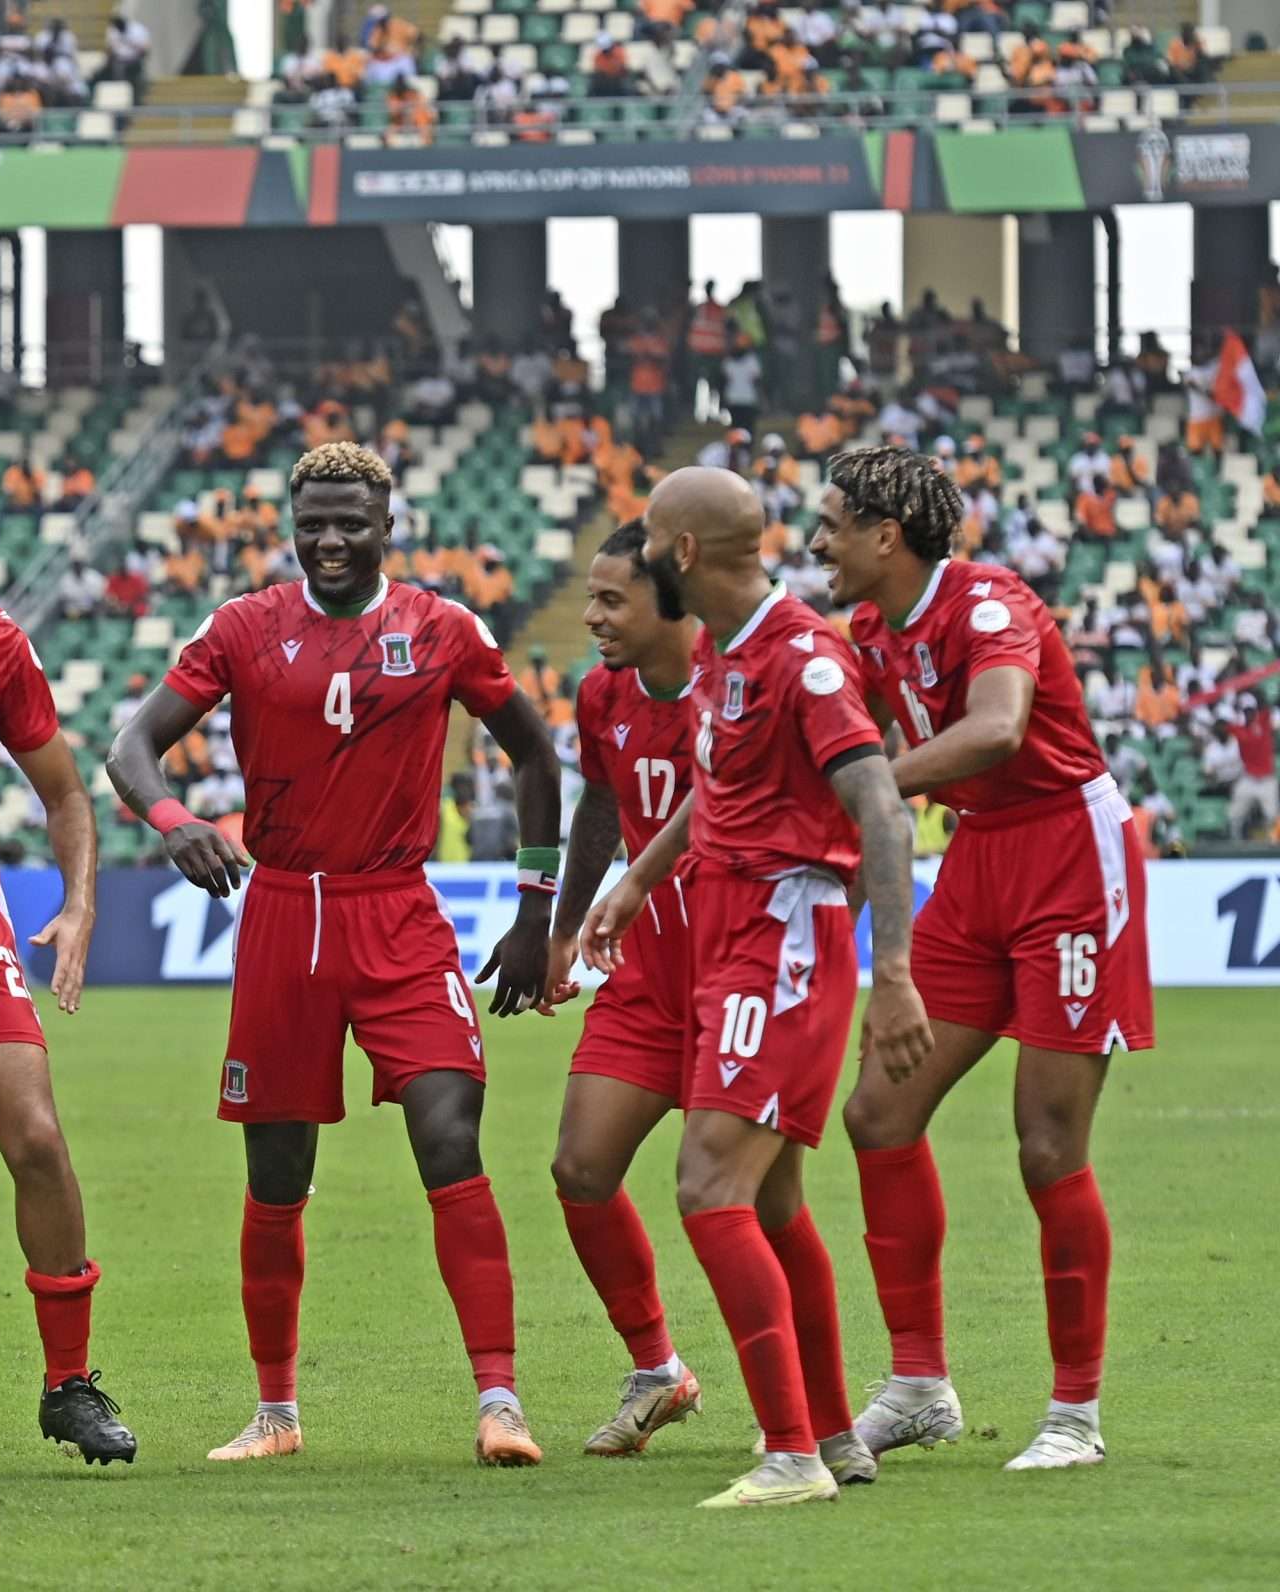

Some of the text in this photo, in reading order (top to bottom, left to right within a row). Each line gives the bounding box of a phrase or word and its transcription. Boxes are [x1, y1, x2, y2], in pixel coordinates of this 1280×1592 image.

[324, 672, 354, 734] 4
[634, 757, 675, 819] 17
[1056, 933, 1098, 997] 16
[444, 971, 475, 1027] 4
[718, 993, 767, 1058] 10
